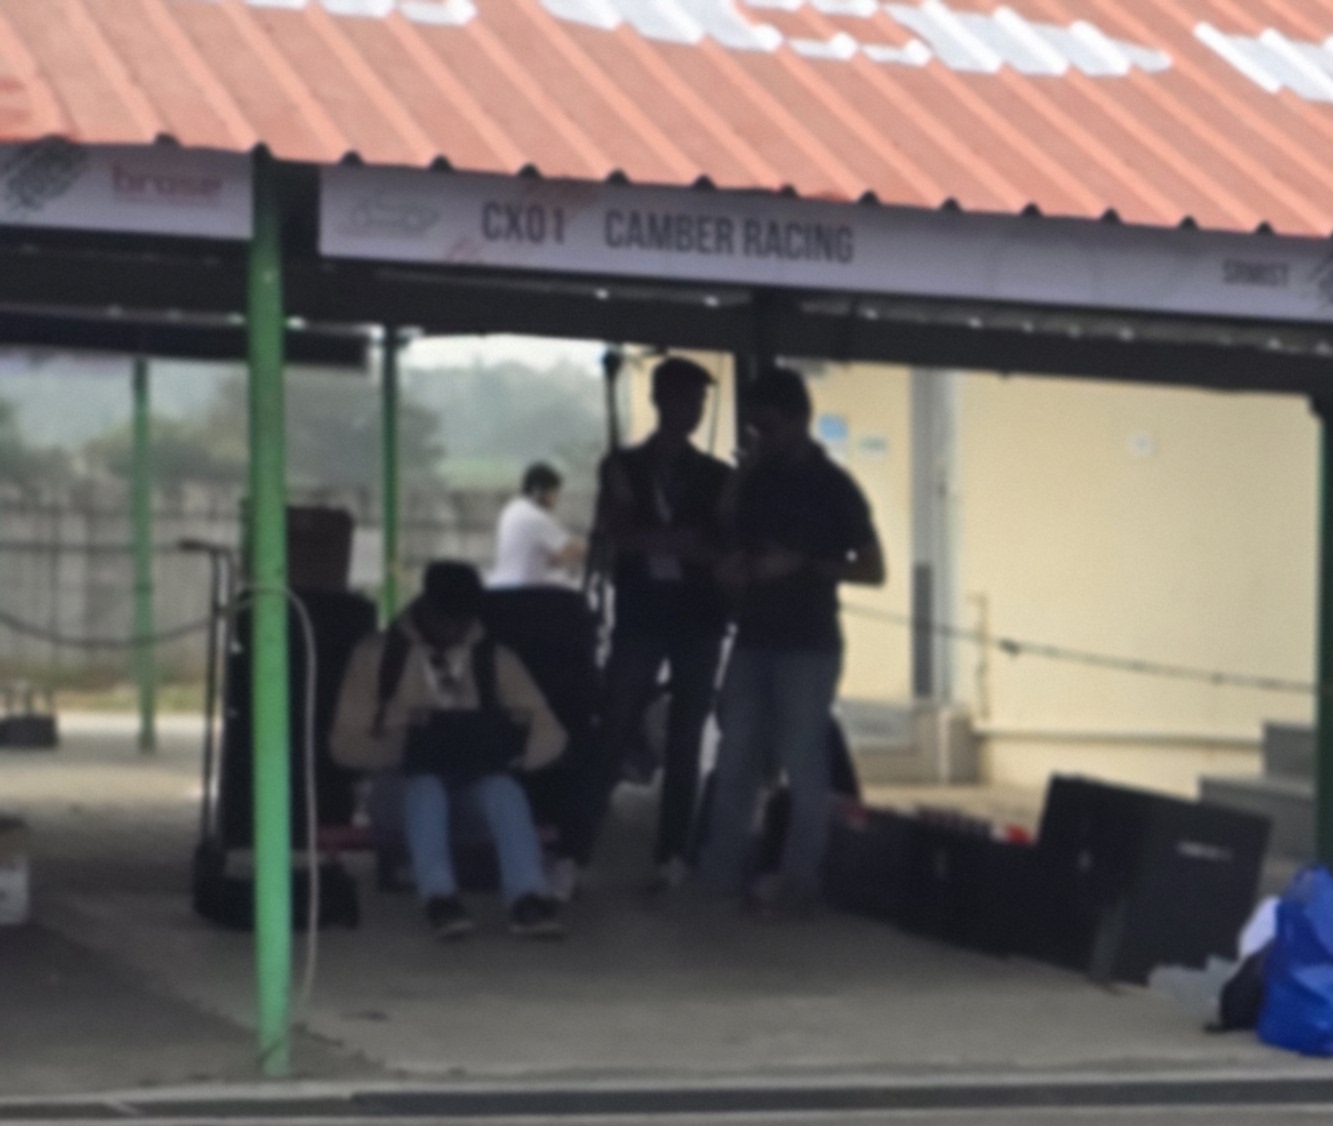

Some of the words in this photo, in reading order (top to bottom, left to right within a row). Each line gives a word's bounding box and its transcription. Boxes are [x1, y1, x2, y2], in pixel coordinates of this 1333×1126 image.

[481, 200, 566, 245] CX01
[603, 208, 734, 258] CAMBER
[742, 217, 855, 265] RACING
